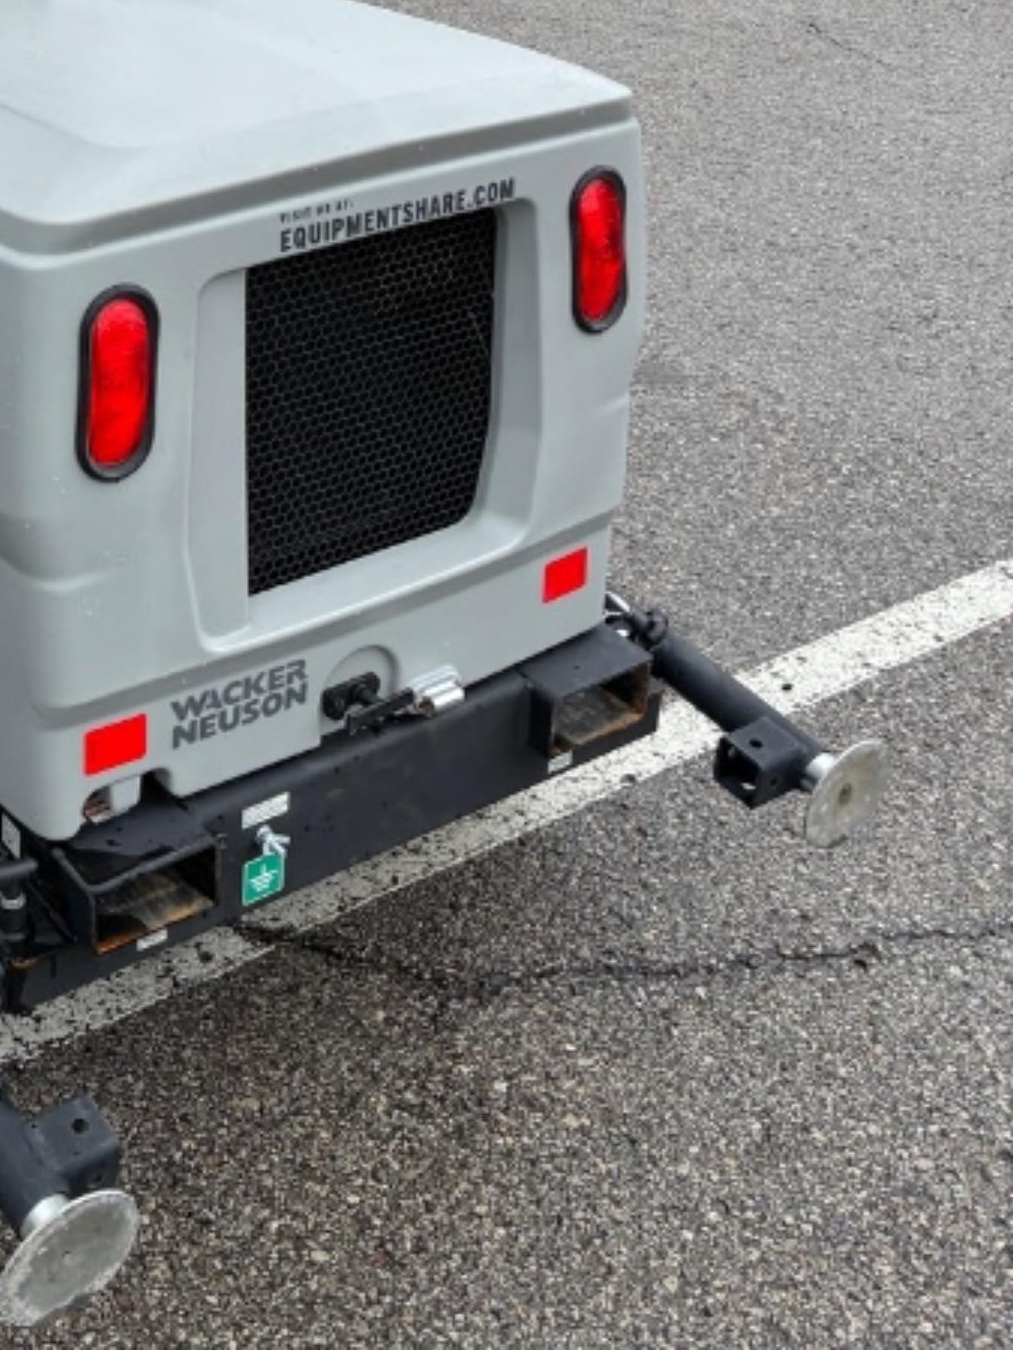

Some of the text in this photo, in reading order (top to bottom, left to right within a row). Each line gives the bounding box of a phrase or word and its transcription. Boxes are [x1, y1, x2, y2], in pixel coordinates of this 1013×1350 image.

[280, 177, 515, 252] EQUIPMENTSHARE.COM
[171, 659, 308, 722] WACKER
[172, 681, 308, 750] NEUSON
